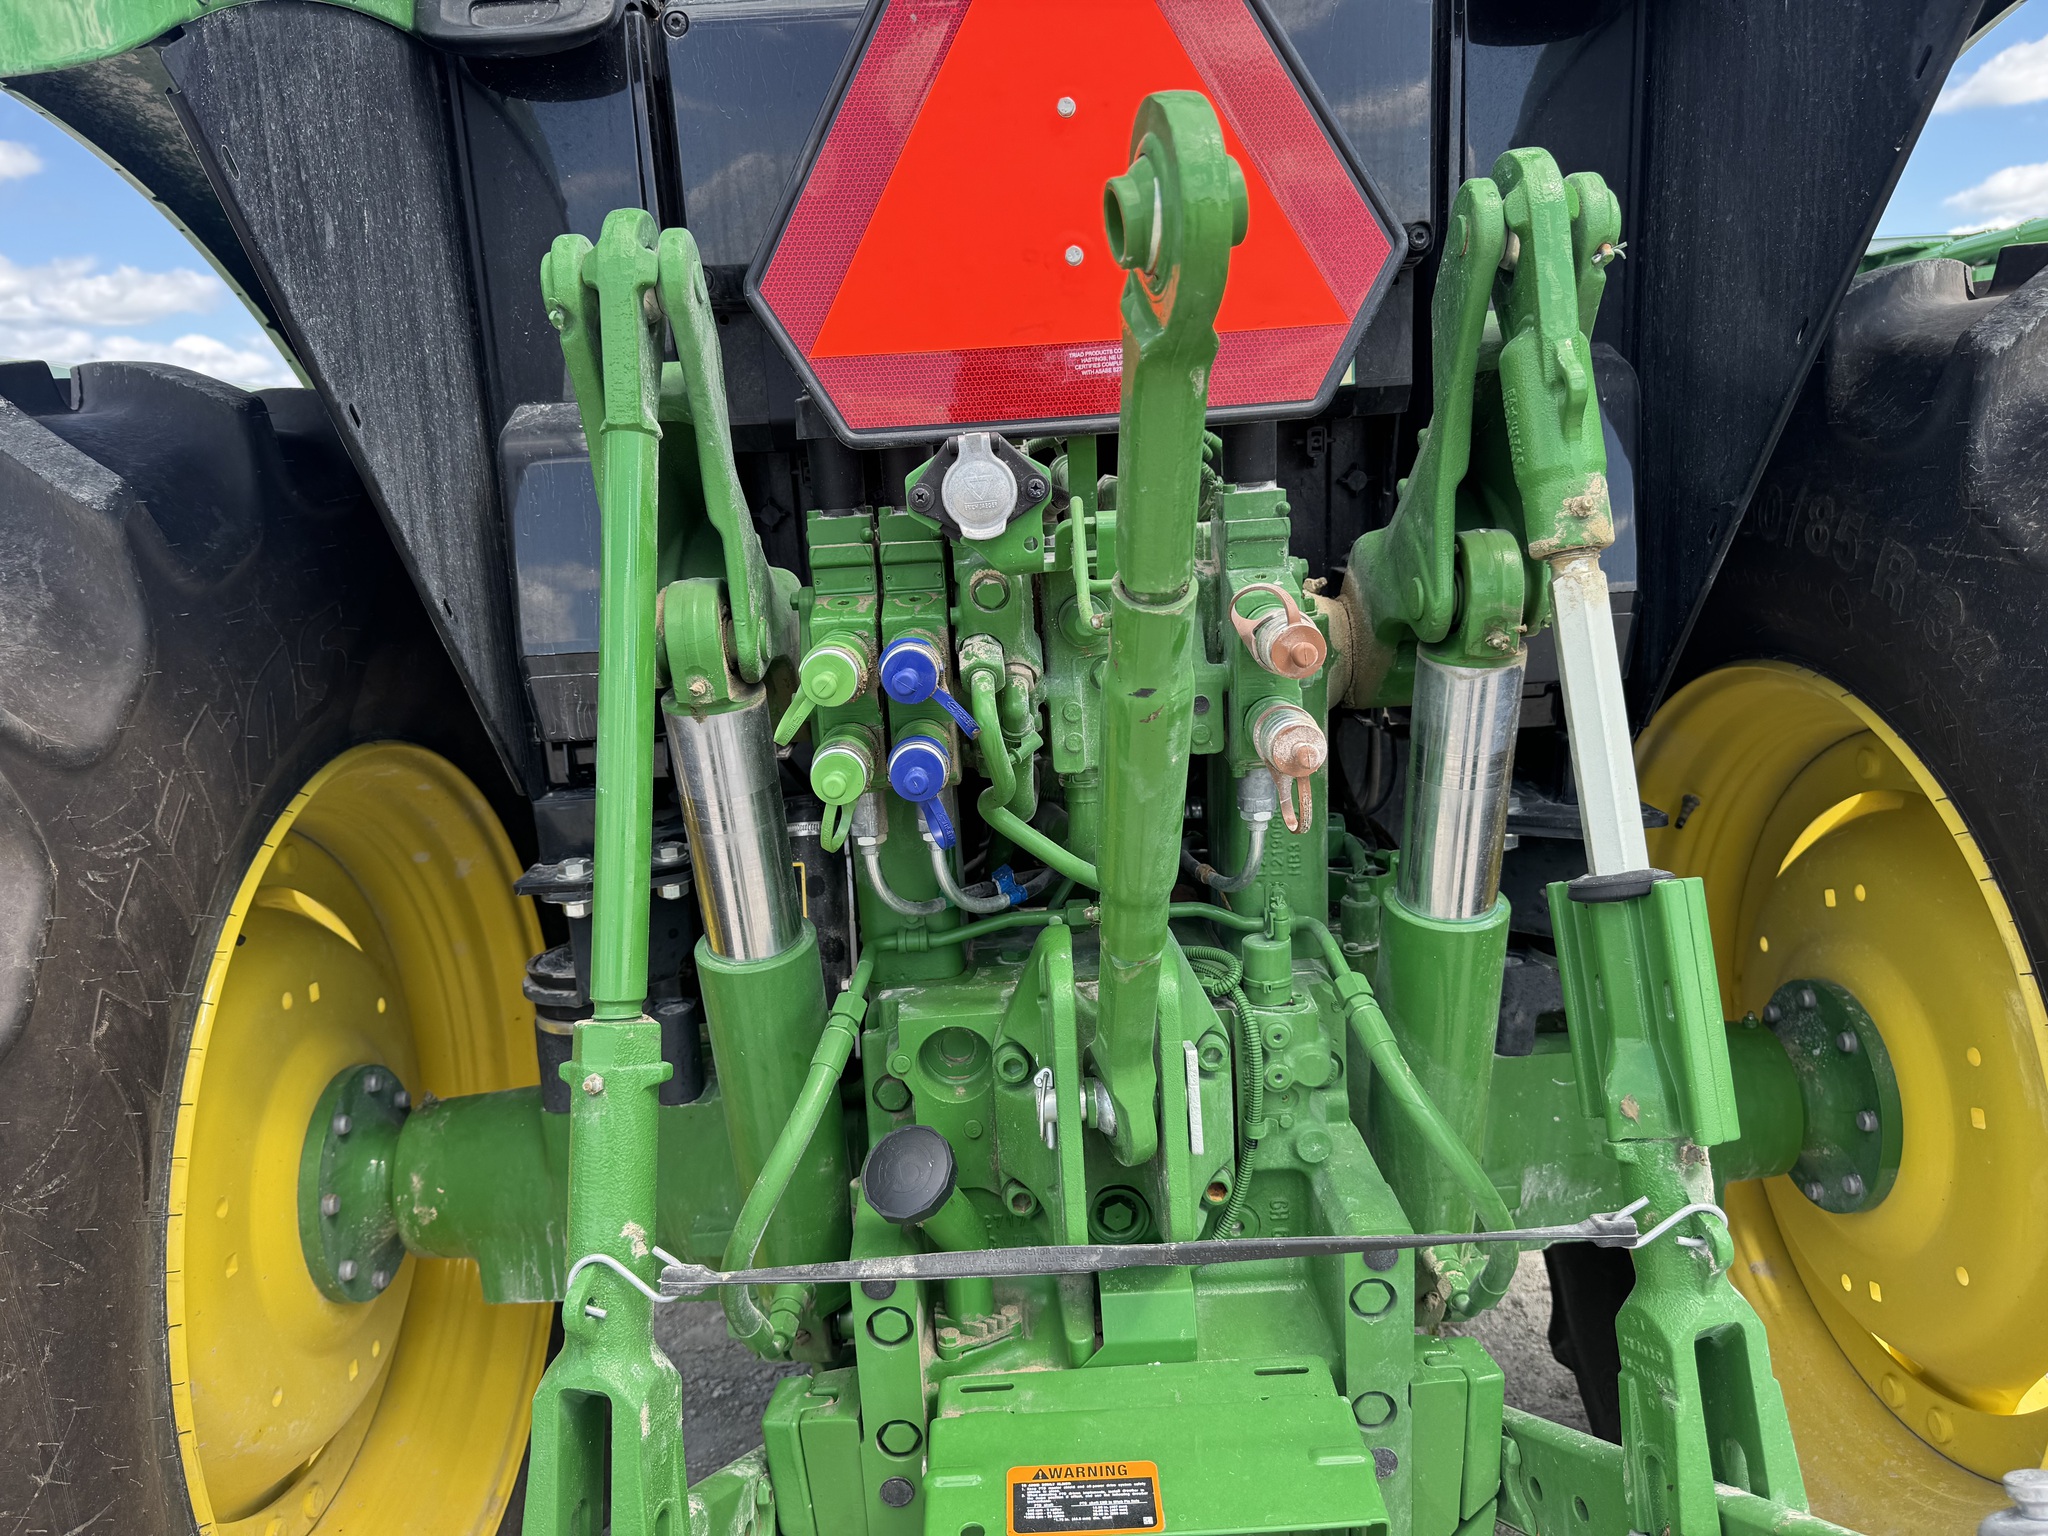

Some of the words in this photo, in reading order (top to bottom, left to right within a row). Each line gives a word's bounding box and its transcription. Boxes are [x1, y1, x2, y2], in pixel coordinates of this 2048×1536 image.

[1017, 1248, 1052, 1257] ANCHOR
[986, 1257, 1026, 1265] SERIOUS
[1048, 1464, 1128, 1479] WARNING
